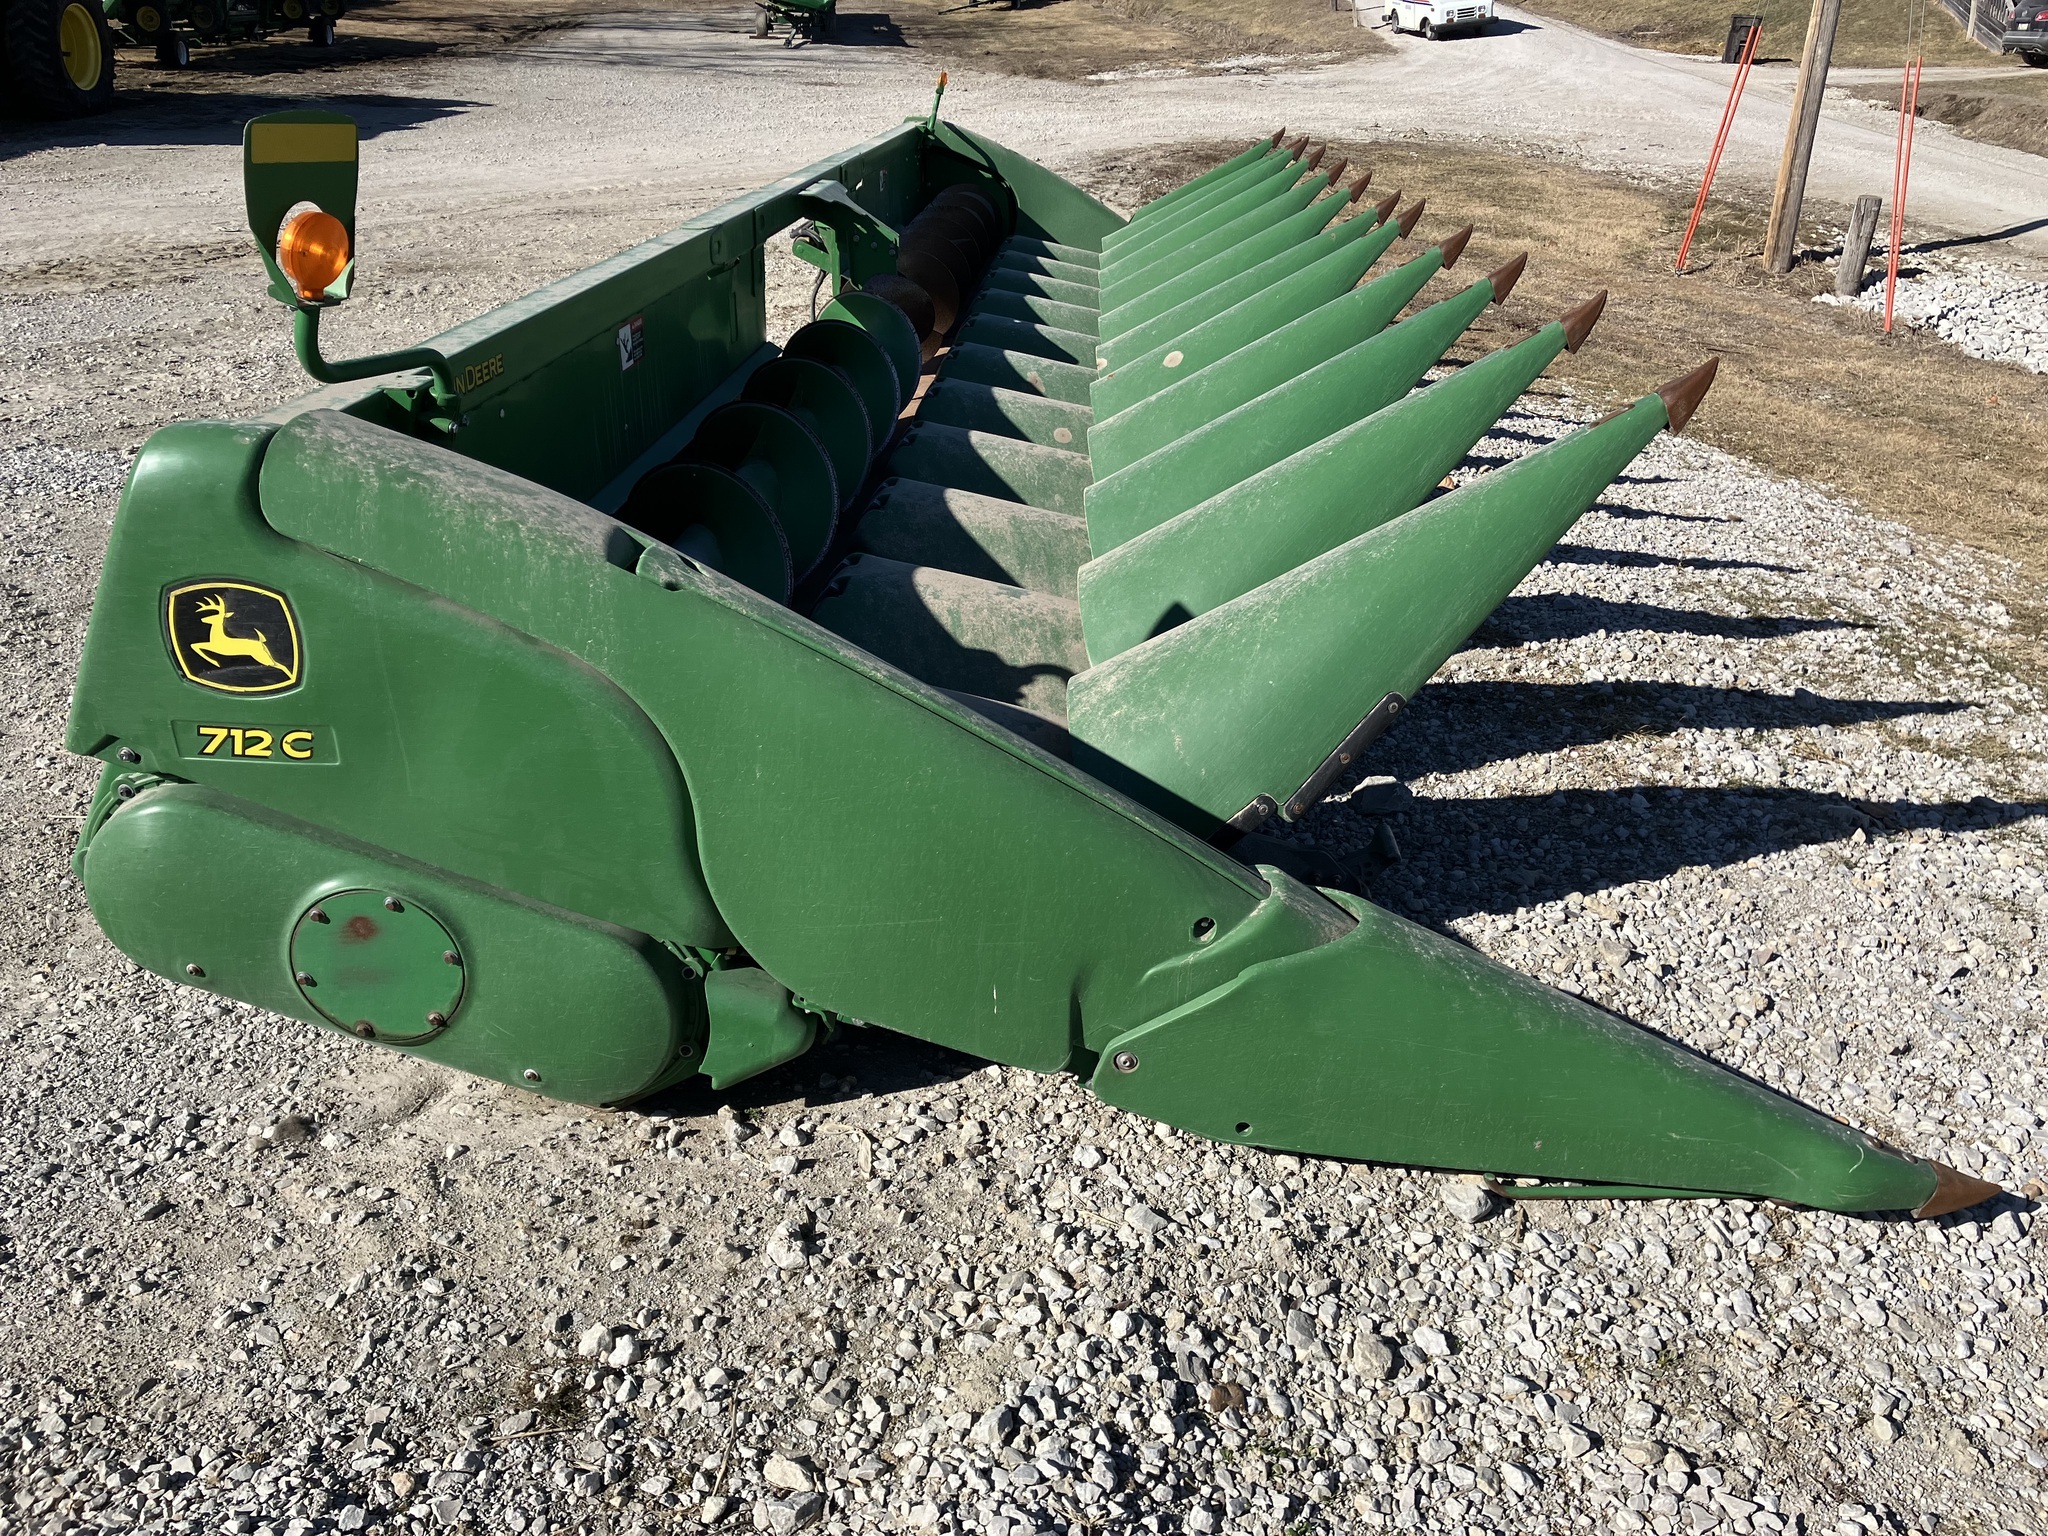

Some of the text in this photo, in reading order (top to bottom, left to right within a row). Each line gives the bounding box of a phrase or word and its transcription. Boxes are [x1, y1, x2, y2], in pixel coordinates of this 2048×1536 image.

[464, 353, 504, 391] DEERE
[198, 725, 313, 760] 712 C
